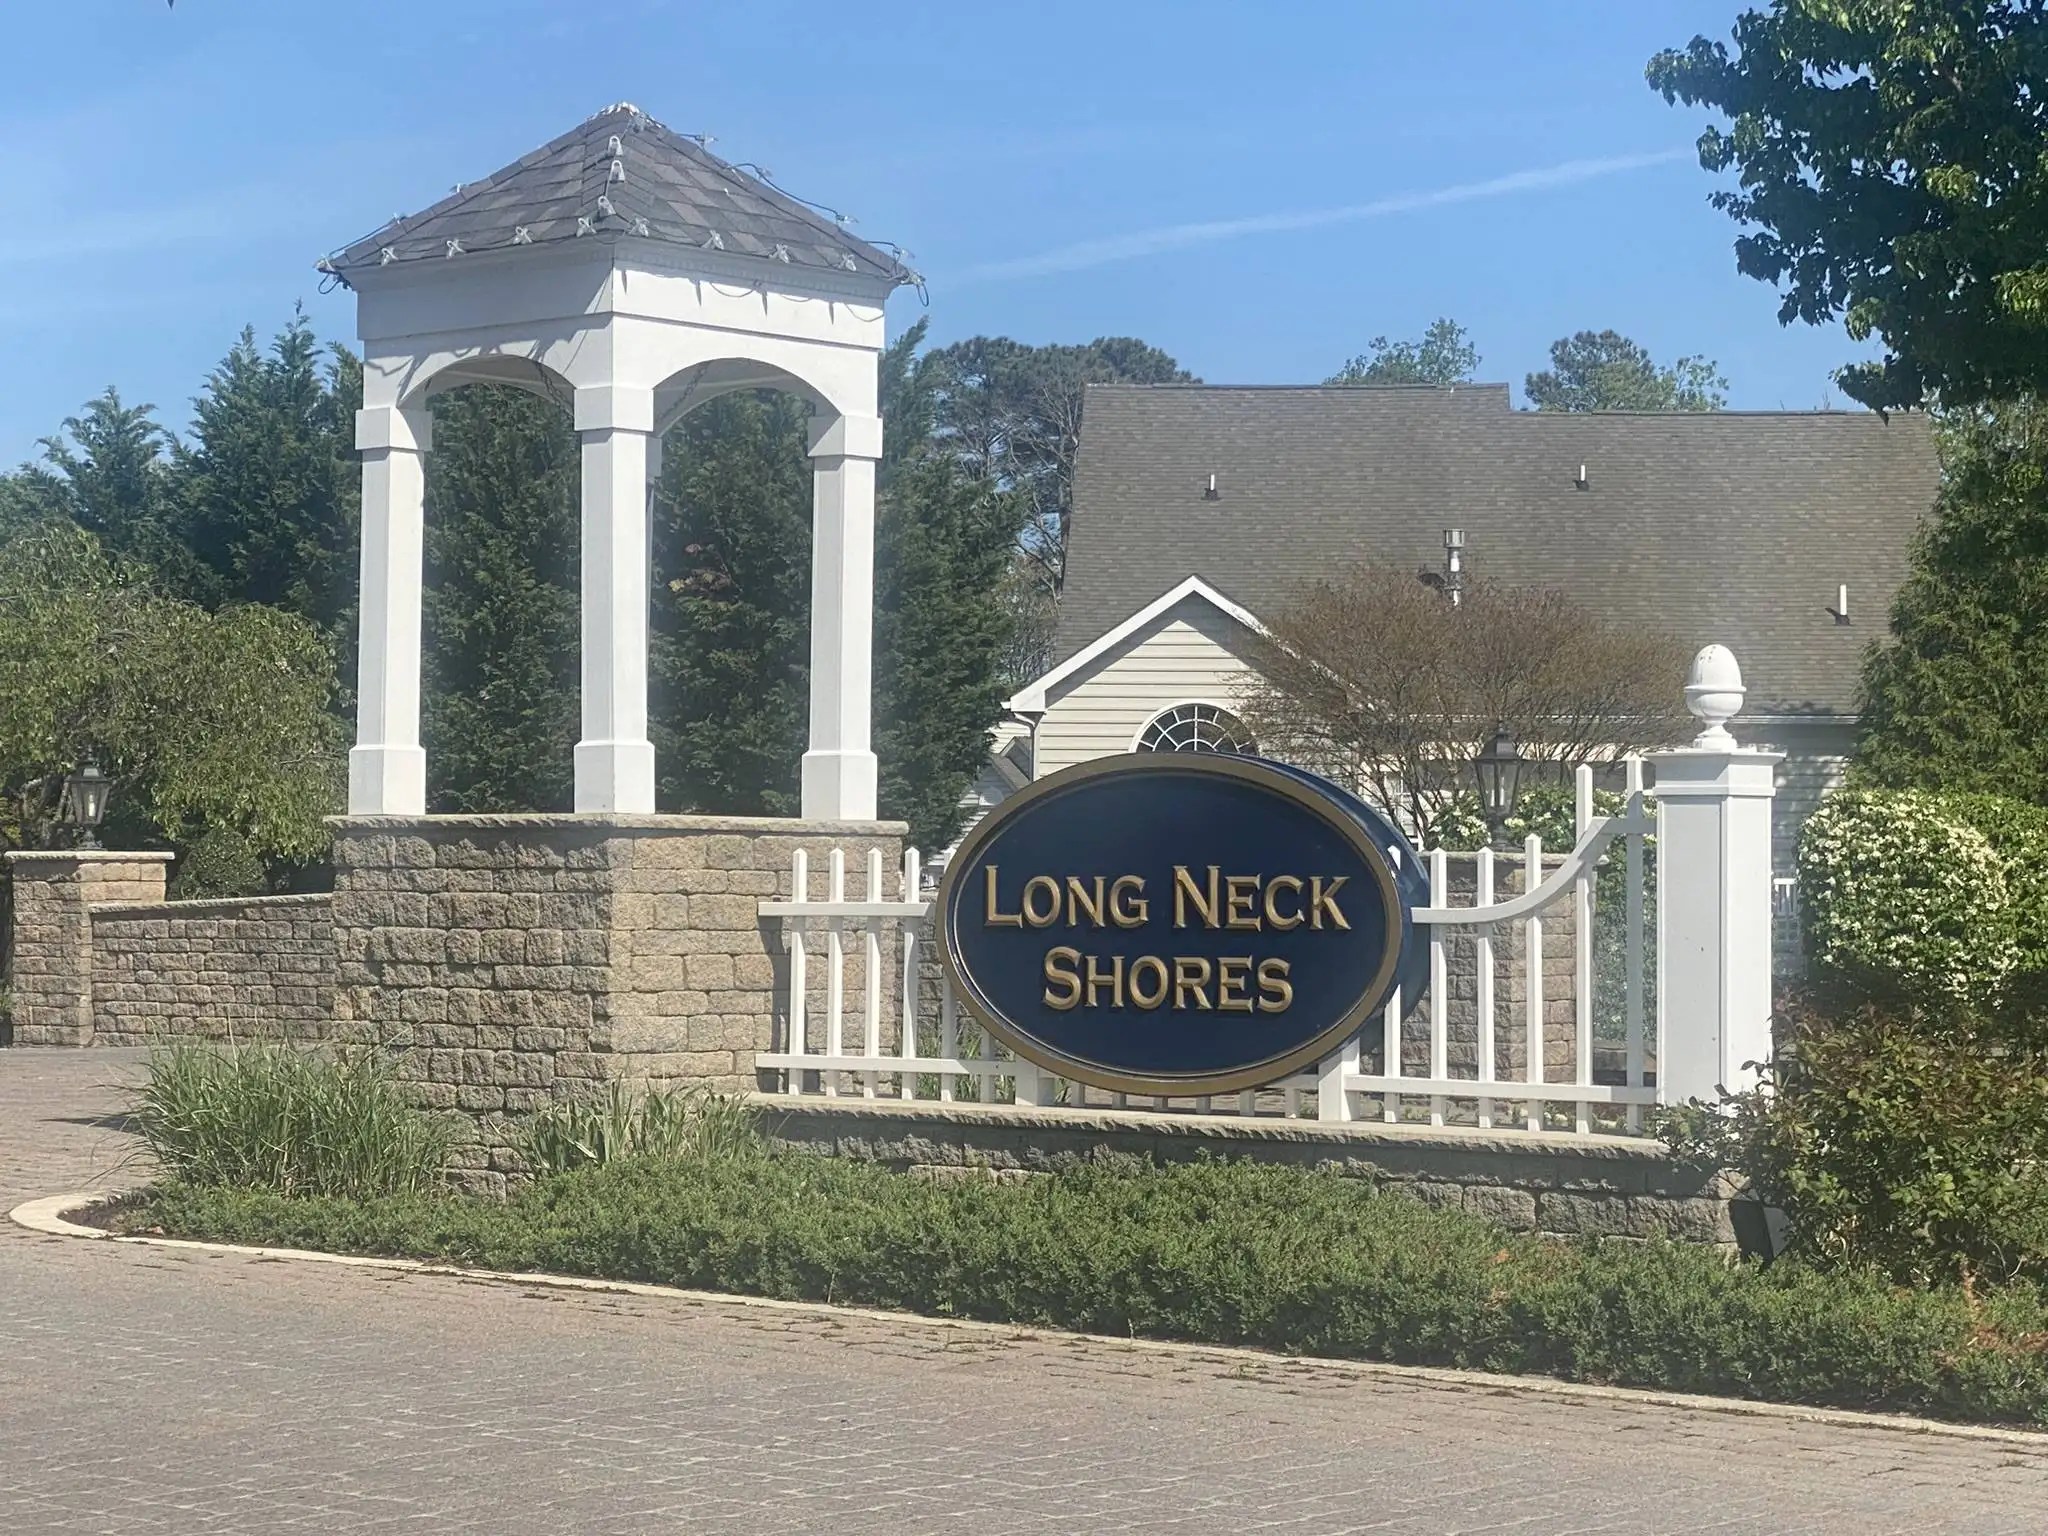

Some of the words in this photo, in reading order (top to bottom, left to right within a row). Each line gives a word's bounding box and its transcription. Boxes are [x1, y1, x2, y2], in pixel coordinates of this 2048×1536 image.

[985, 865, 1149, 928] LONG
[1172, 865, 1352, 931] NECK
[1042, 946, 1294, 1013] SHORES
